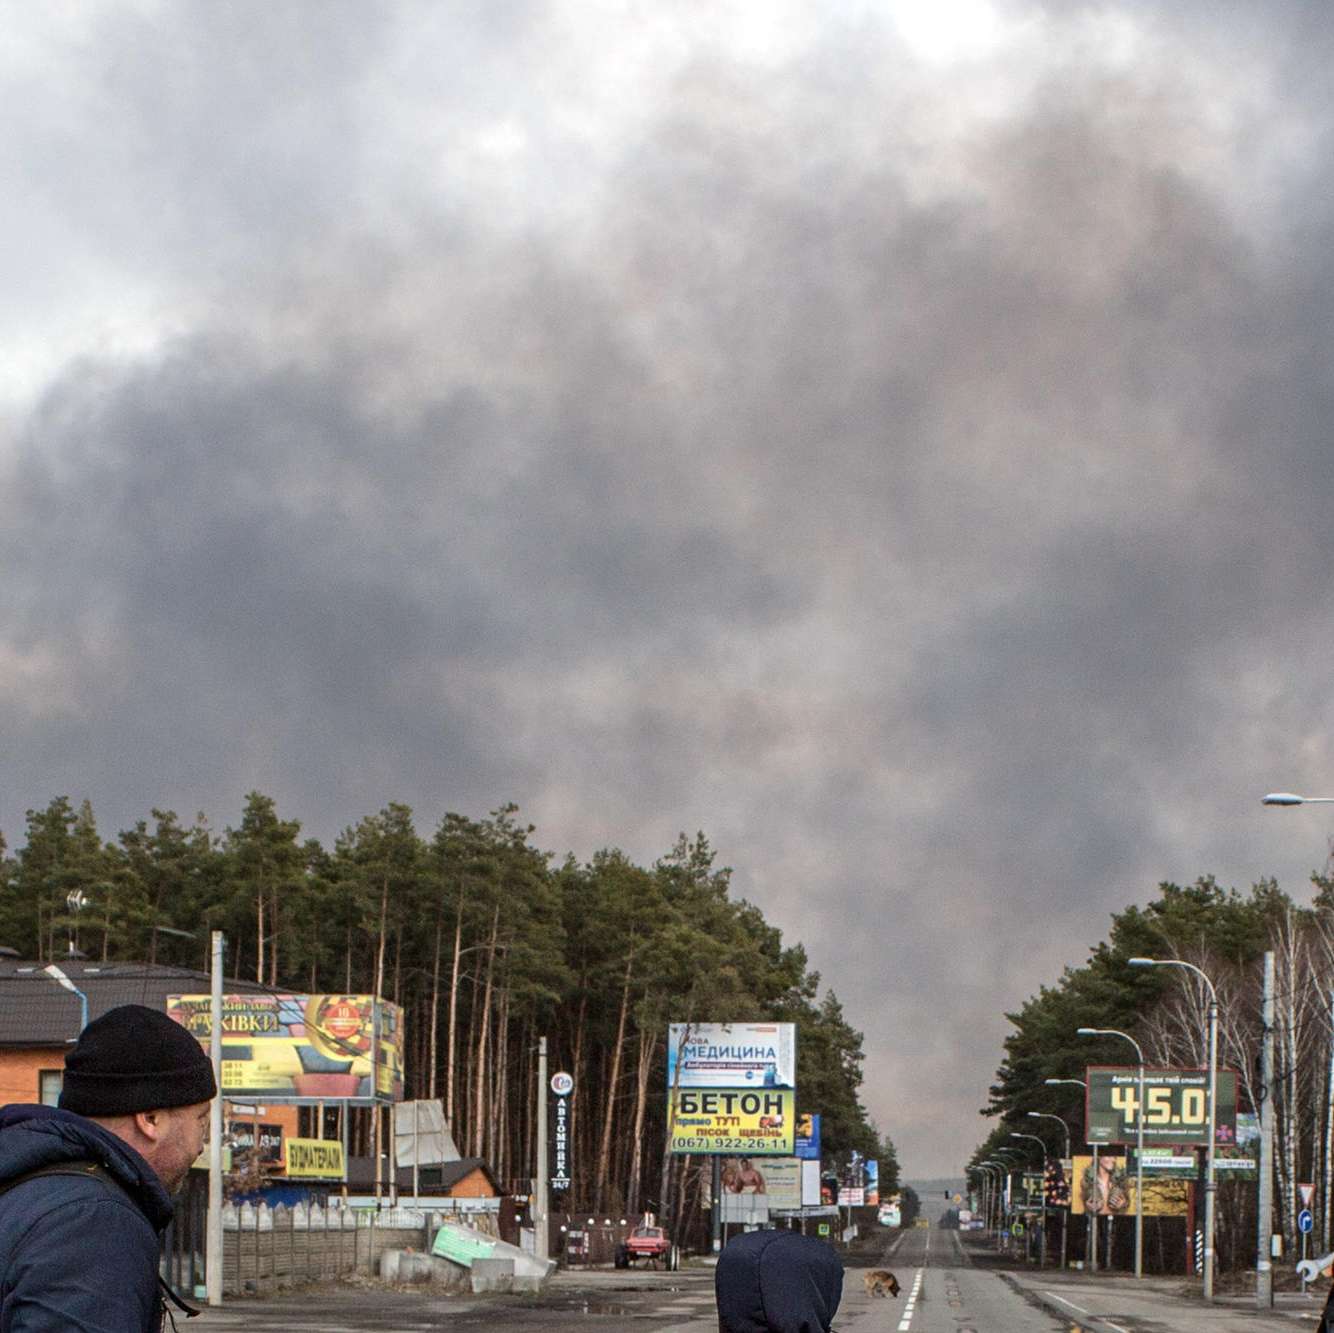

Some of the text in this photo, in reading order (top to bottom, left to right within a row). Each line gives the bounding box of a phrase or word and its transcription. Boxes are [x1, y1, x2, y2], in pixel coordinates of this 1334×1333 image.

[684, 1046, 776, 1060] МЕДИЦИНА
[680, 1092, 783, 1115] БЕТОН
[696, 1128, 729, 1137] ПІСОК
[672, 1138, 709, 1149] (067)
[715, 1138, 787, 1149] 922-26-11
